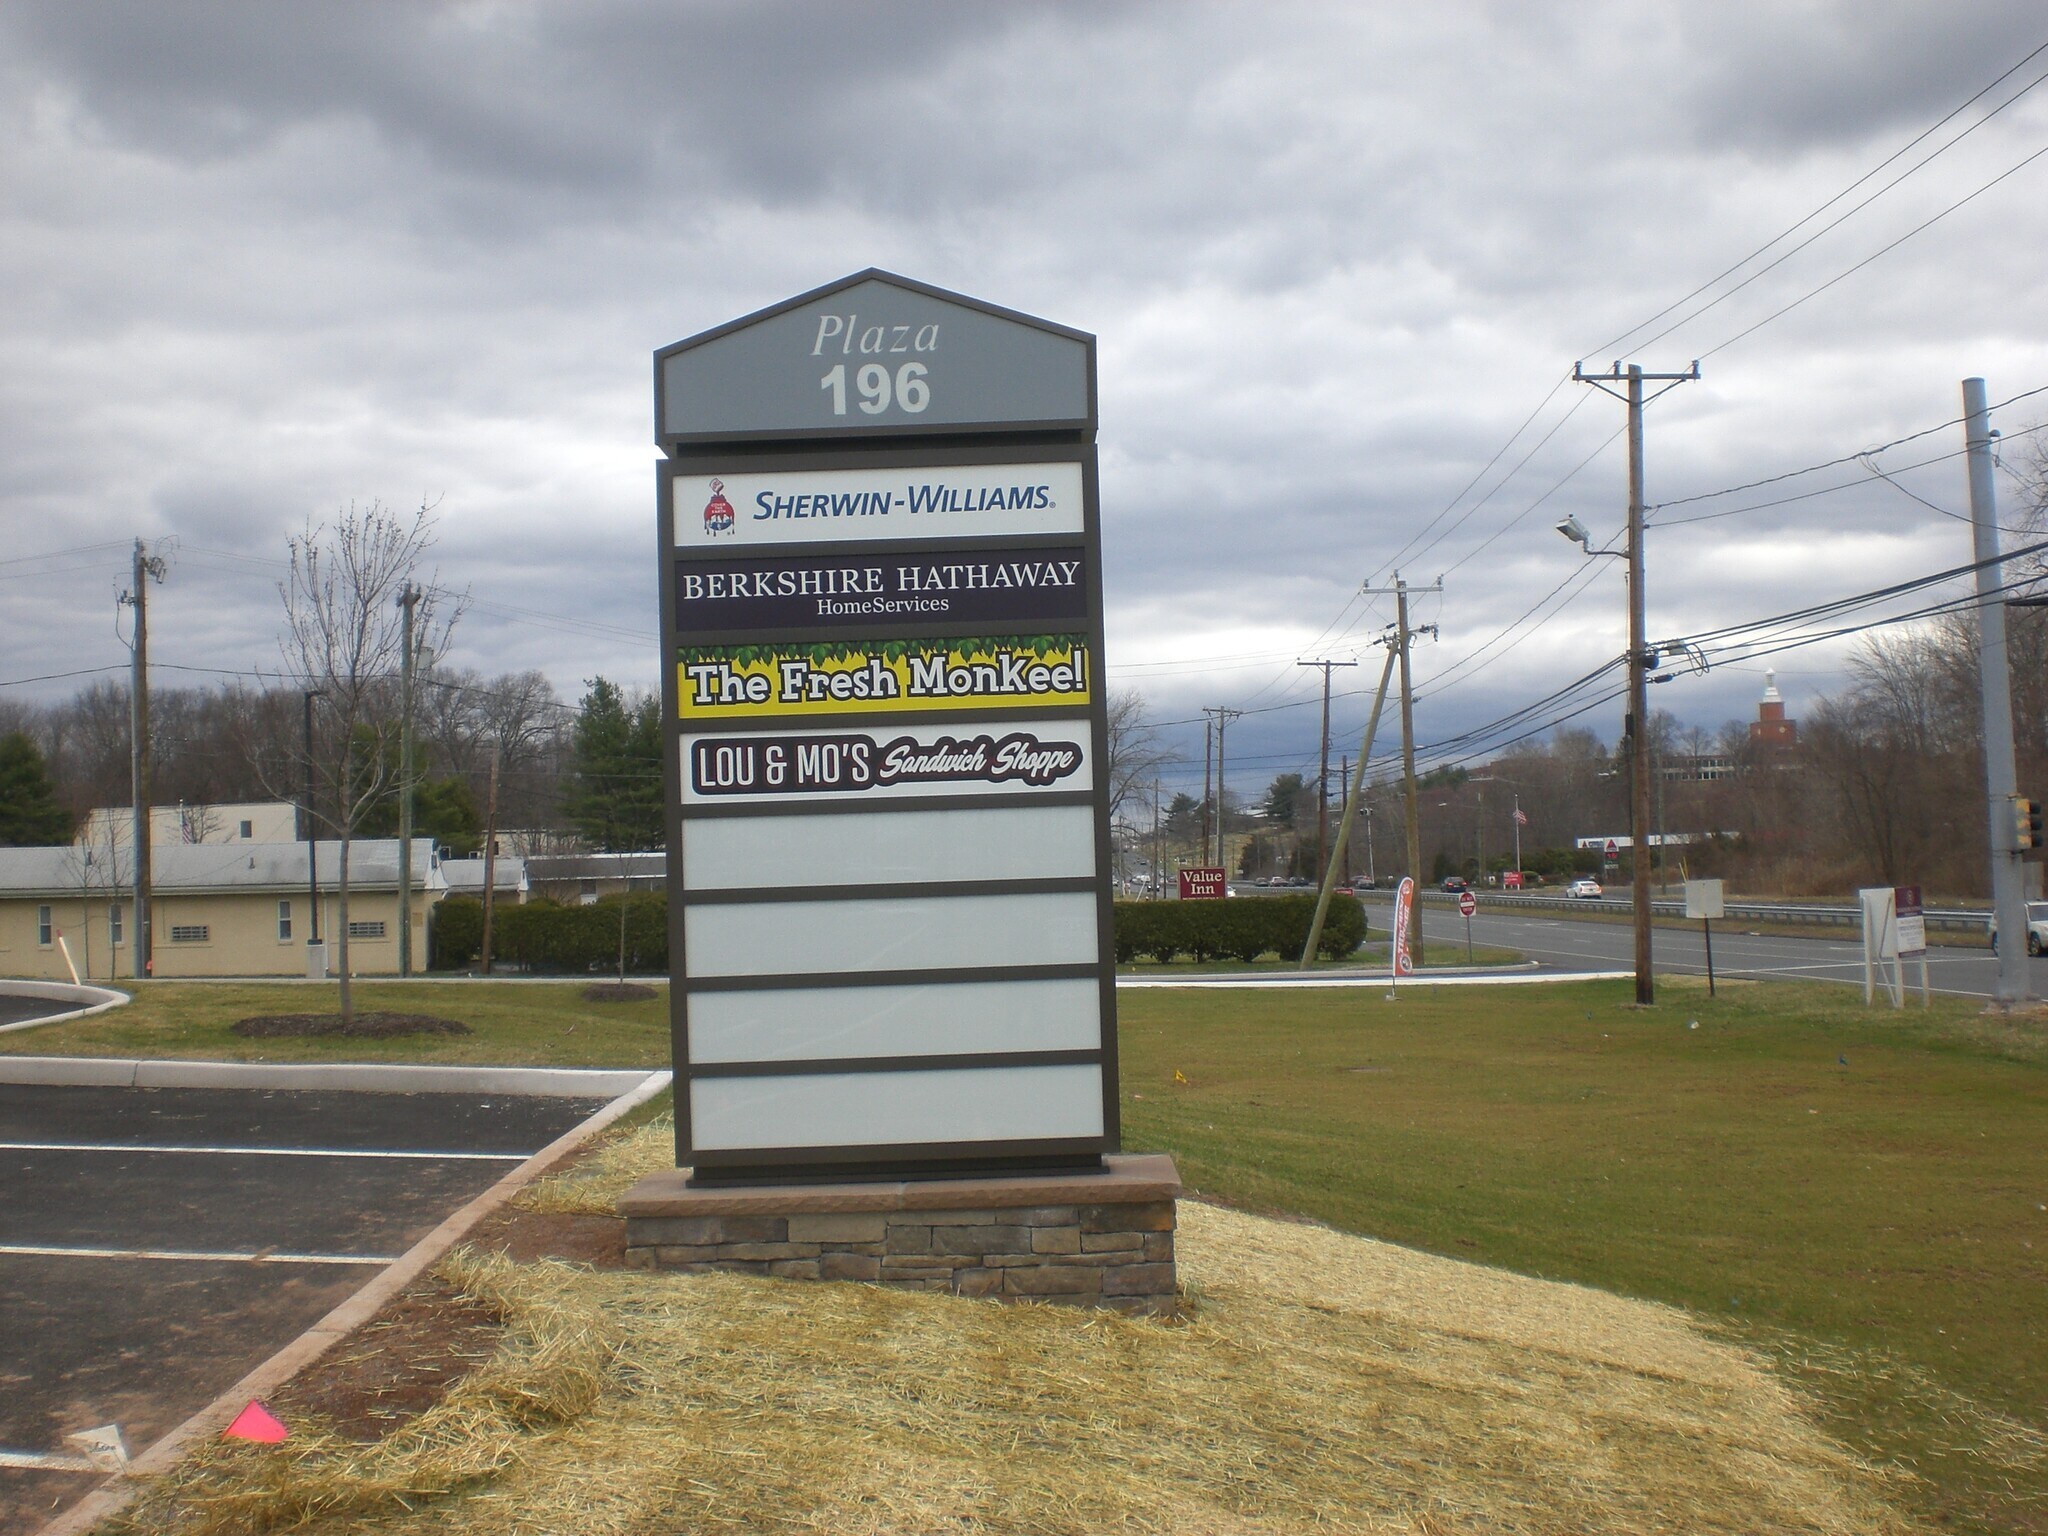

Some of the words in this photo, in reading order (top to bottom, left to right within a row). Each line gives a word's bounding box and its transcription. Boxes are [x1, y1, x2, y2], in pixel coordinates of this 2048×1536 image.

[810, 314, 940, 356] Plaza
[820, 362, 931, 415] 196
[683, 567, 884, 600] BERKSHIRE
[897, 561, 1081, 592] HATHAWAY
[817, 597, 950, 616] HomeServices
[687, 664, 770, 704] The
[780, 659, 898, 700] Fresh
[699, 745, 755, 788] LOU
[765, 745, 788, 786] &
[797, 742, 871, 785] MO'S
[879, 742, 987, 779] Sandwich
[990, 740, 1075, 779] Shoppe
[1183, 871, 1222, 882] Value
[1191, 884, 1215, 895] Inn
